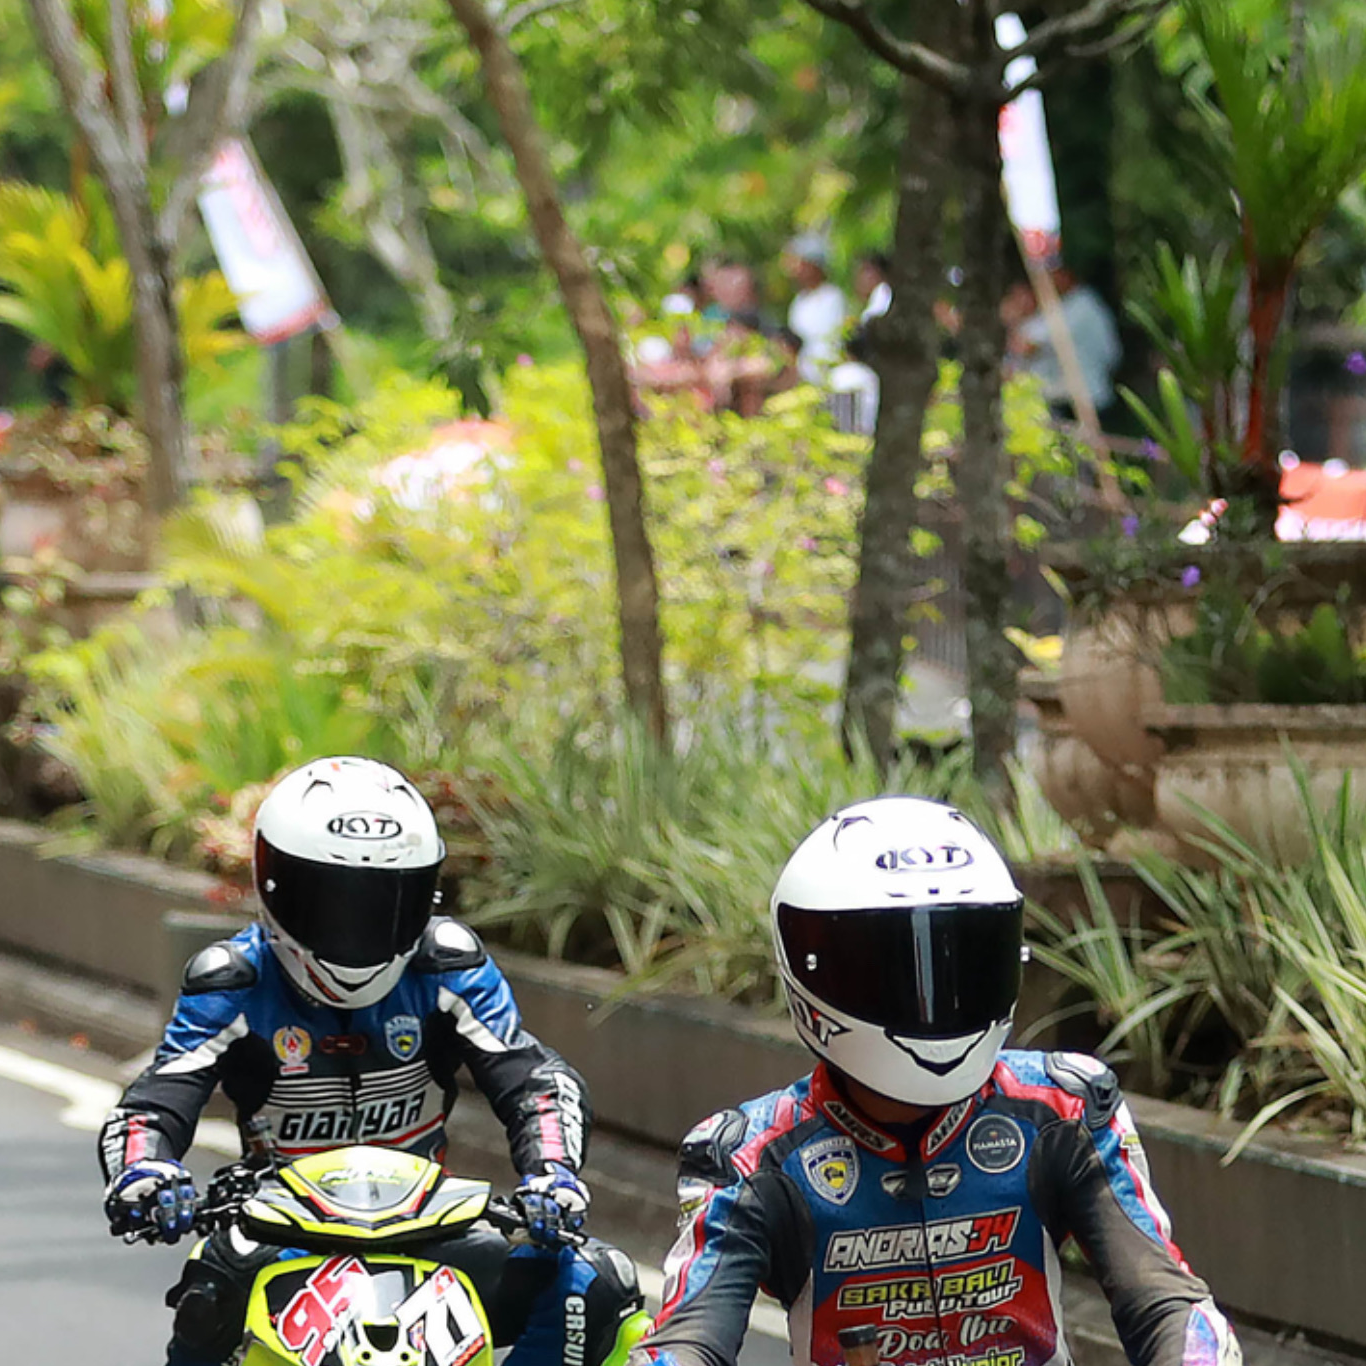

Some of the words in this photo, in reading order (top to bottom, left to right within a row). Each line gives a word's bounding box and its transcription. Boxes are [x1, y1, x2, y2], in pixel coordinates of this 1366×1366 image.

[327, 811, 402, 840] KYT
[875, 842, 975, 873] KYT
[941, 1261, 1012, 1298] BALI
